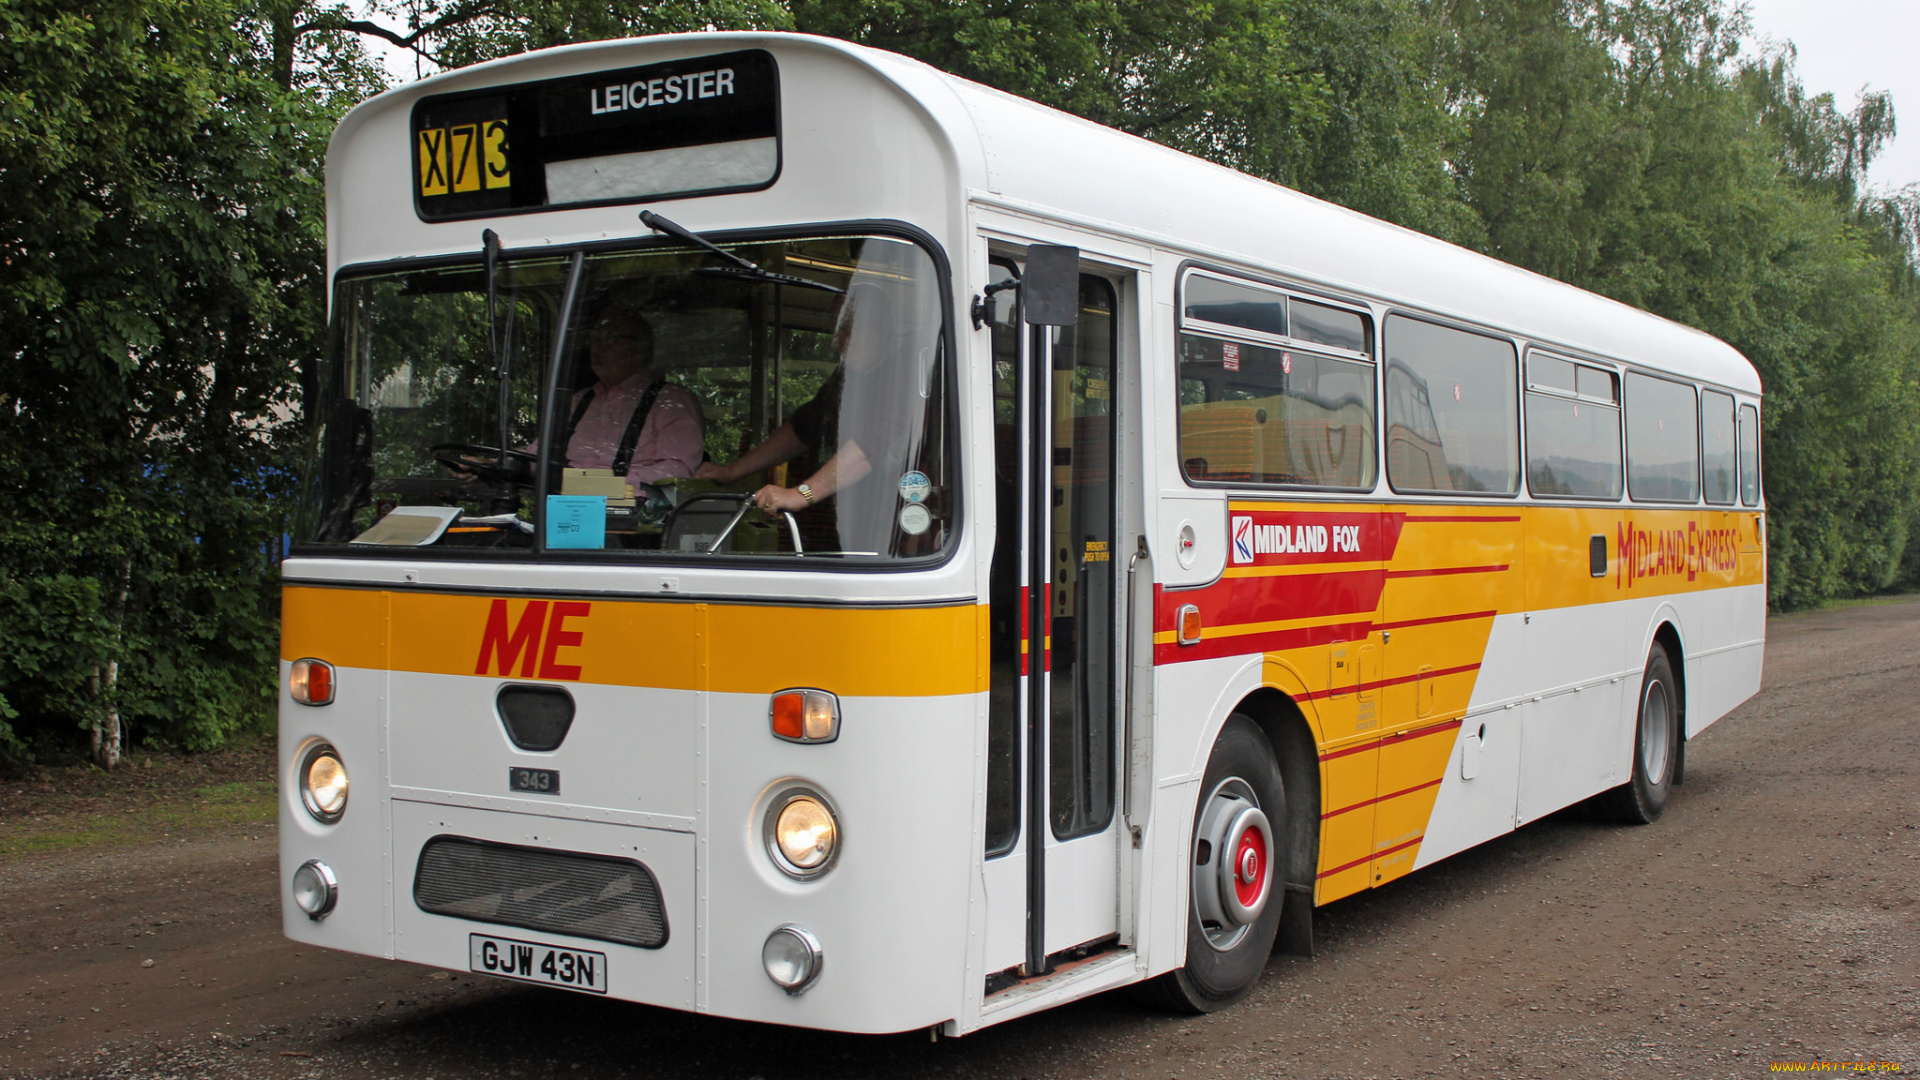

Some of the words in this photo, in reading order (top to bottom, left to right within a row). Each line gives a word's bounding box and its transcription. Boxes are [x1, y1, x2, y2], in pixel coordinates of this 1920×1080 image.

[591, 68, 735, 116] LEICESTER
[421, 120, 511, 188] X73
[1254, 524, 1328, 555] MIDLAND
[1333, 525, 1360, 553] FOX
[1617, 521, 1685, 589] MIDLAND
[1687, 521, 1737, 582] EXPRESS
[475, 598, 592, 682] ME
[519, 771, 550, 790] 343
[482, 940, 534, 977] GJW
[540, 949, 595, 987] 43N
